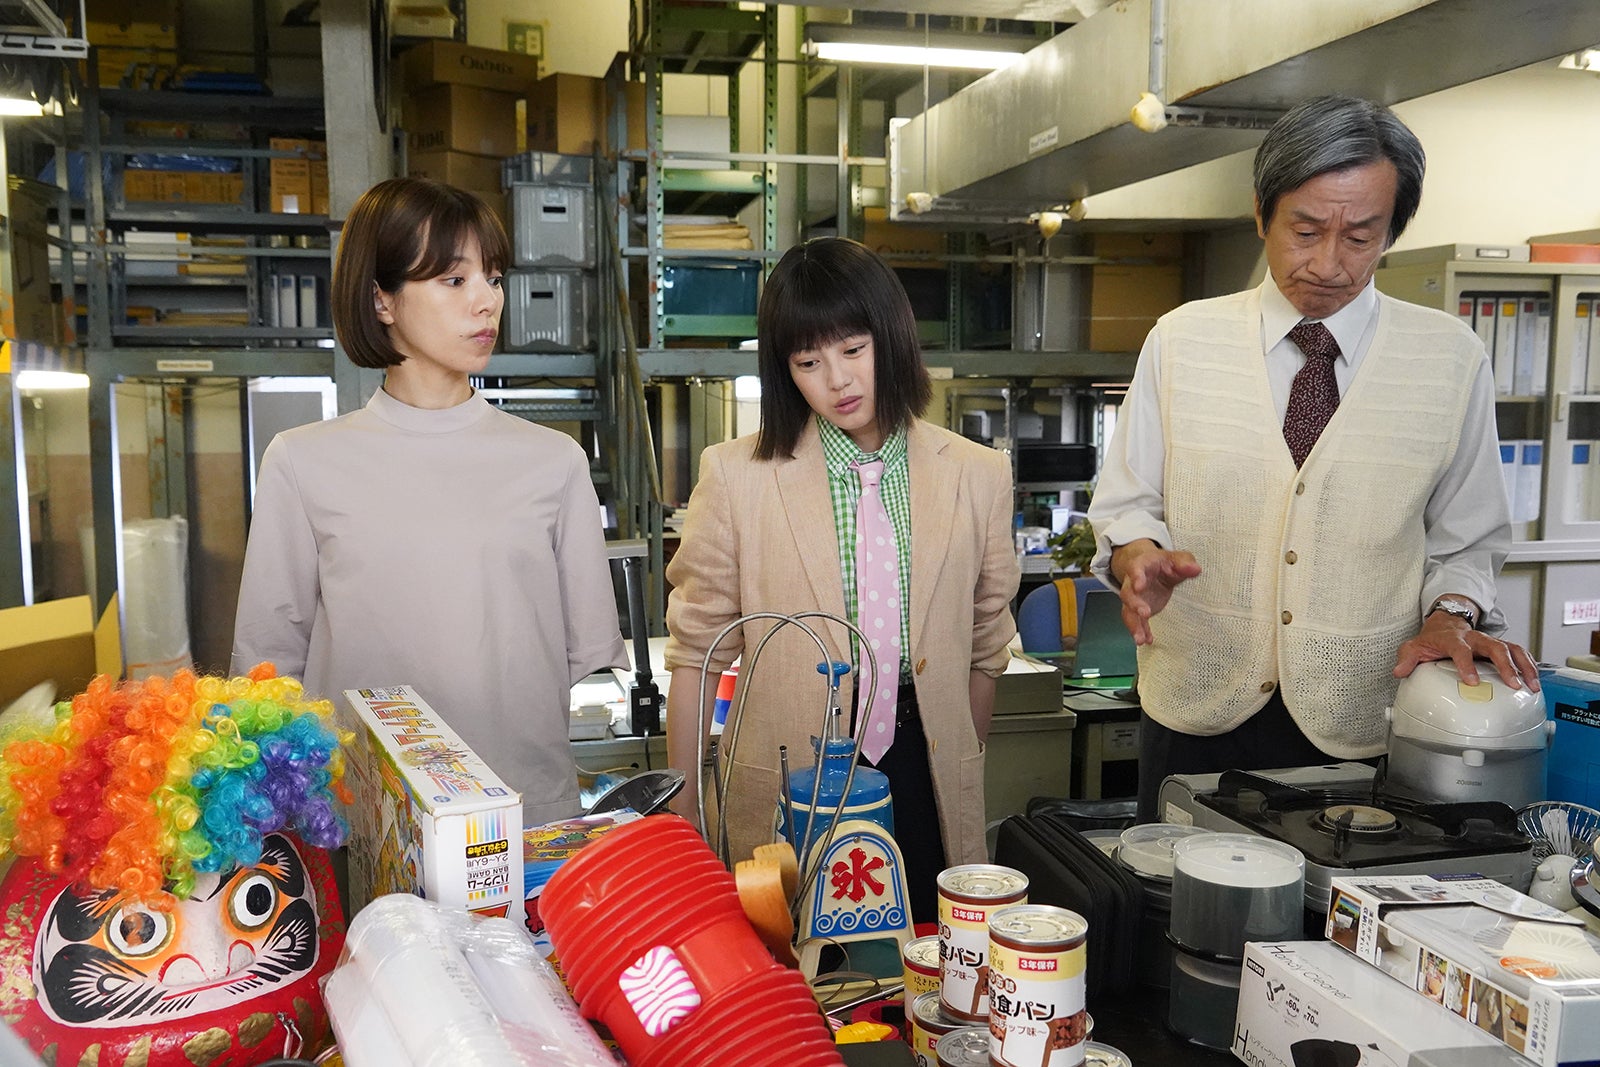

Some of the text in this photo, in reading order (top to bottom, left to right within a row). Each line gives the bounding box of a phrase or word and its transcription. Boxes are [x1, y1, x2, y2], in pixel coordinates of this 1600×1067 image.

[831, 848, 885, 903] 氷
[953, 909, 984, 921] 3年保存
[1020, 960, 1056, 971] 3年保存
[1261, 945, 1302, 972] Handy
